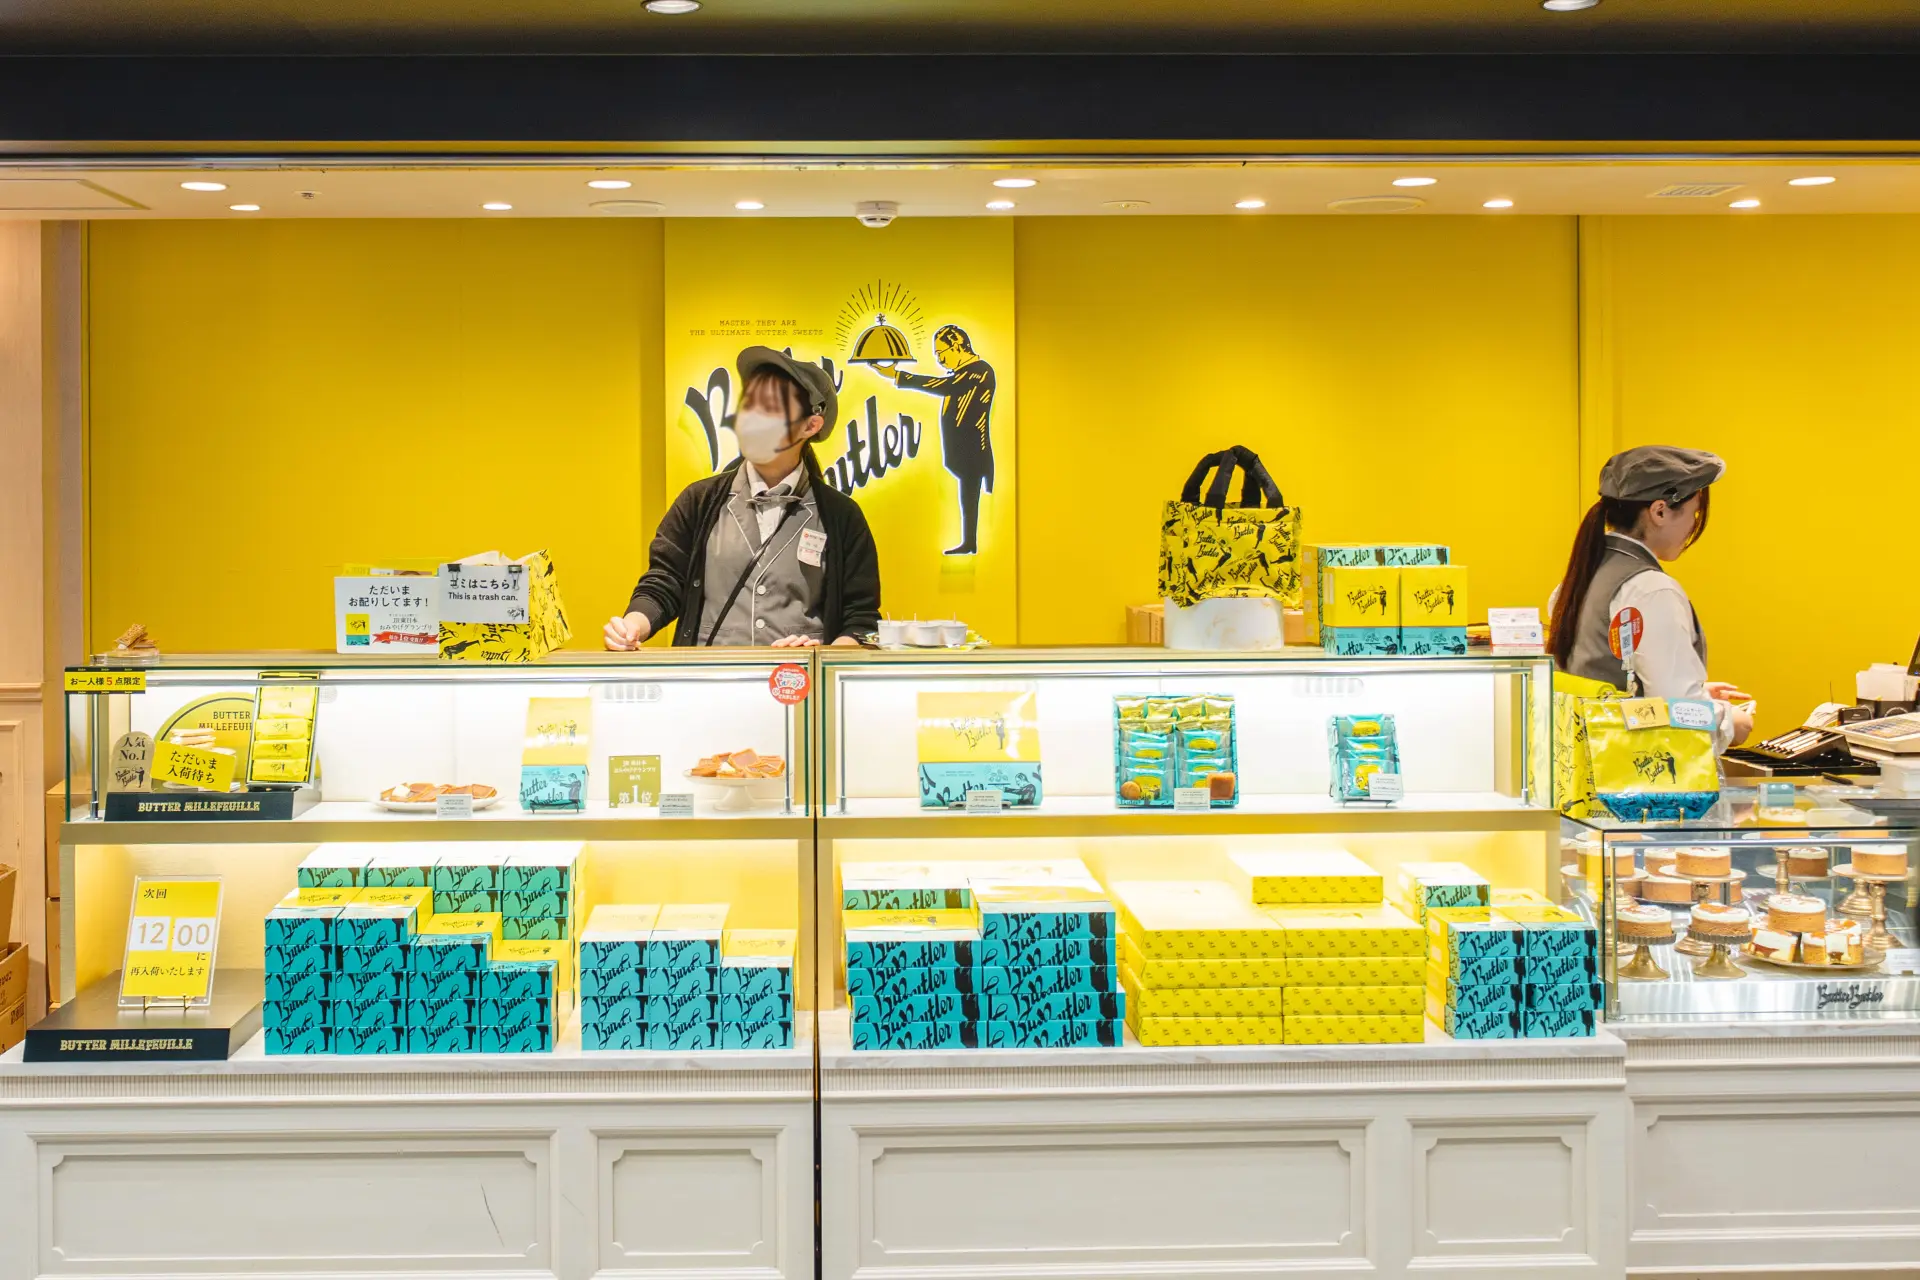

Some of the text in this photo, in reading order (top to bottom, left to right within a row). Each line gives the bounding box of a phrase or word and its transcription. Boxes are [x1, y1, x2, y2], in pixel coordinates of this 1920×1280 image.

[823, 395, 921, 496] utler
[369, 585, 410, 595] ただいま
[448, 592, 463, 600] This
[464, 592, 471, 600] is
[478, 592, 500, 600] trash
[1346, 588, 1368, 606] Butter
[1414, 588, 1436, 605] Butter
[348, 597, 429, 607] お配りしてます！
[1357, 594, 1378, 614] Butler
[1424, 594, 1445, 614] Butler
[70, 676, 141, 686] お一人様5点限定
[213, 711, 251, 720] BUTTER
[122, 736, 146, 748] 人気
[119, 749, 146, 761] No.1
[170, 750, 218, 770] ただいま
[167, 764, 216, 784] 入荷待ち
[137, 801, 260, 812] BUTTER MILLEFEUILLE
[143, 888, 168, 899] 次回
[1470, 931, 1508, 957] Butler
[1542, 930, 1579, 957] Butler
[196, 951, 206, 961] に
[130, 966, 205, 977] 再入荷いたします
[1471, 957, 1509, 984] Butler
[1541, 956, 1578, 984] Butler
[1468, 985, 1506, 1012] Butler
[1548, 984, 1585, 1011] Butler
[1466, 1011, 1504, 1039] Butler
[1540, 1011, 1577, 1038] Butler
[60, 1038, 194, 1051] BUTTER MILLEFEUILLE
